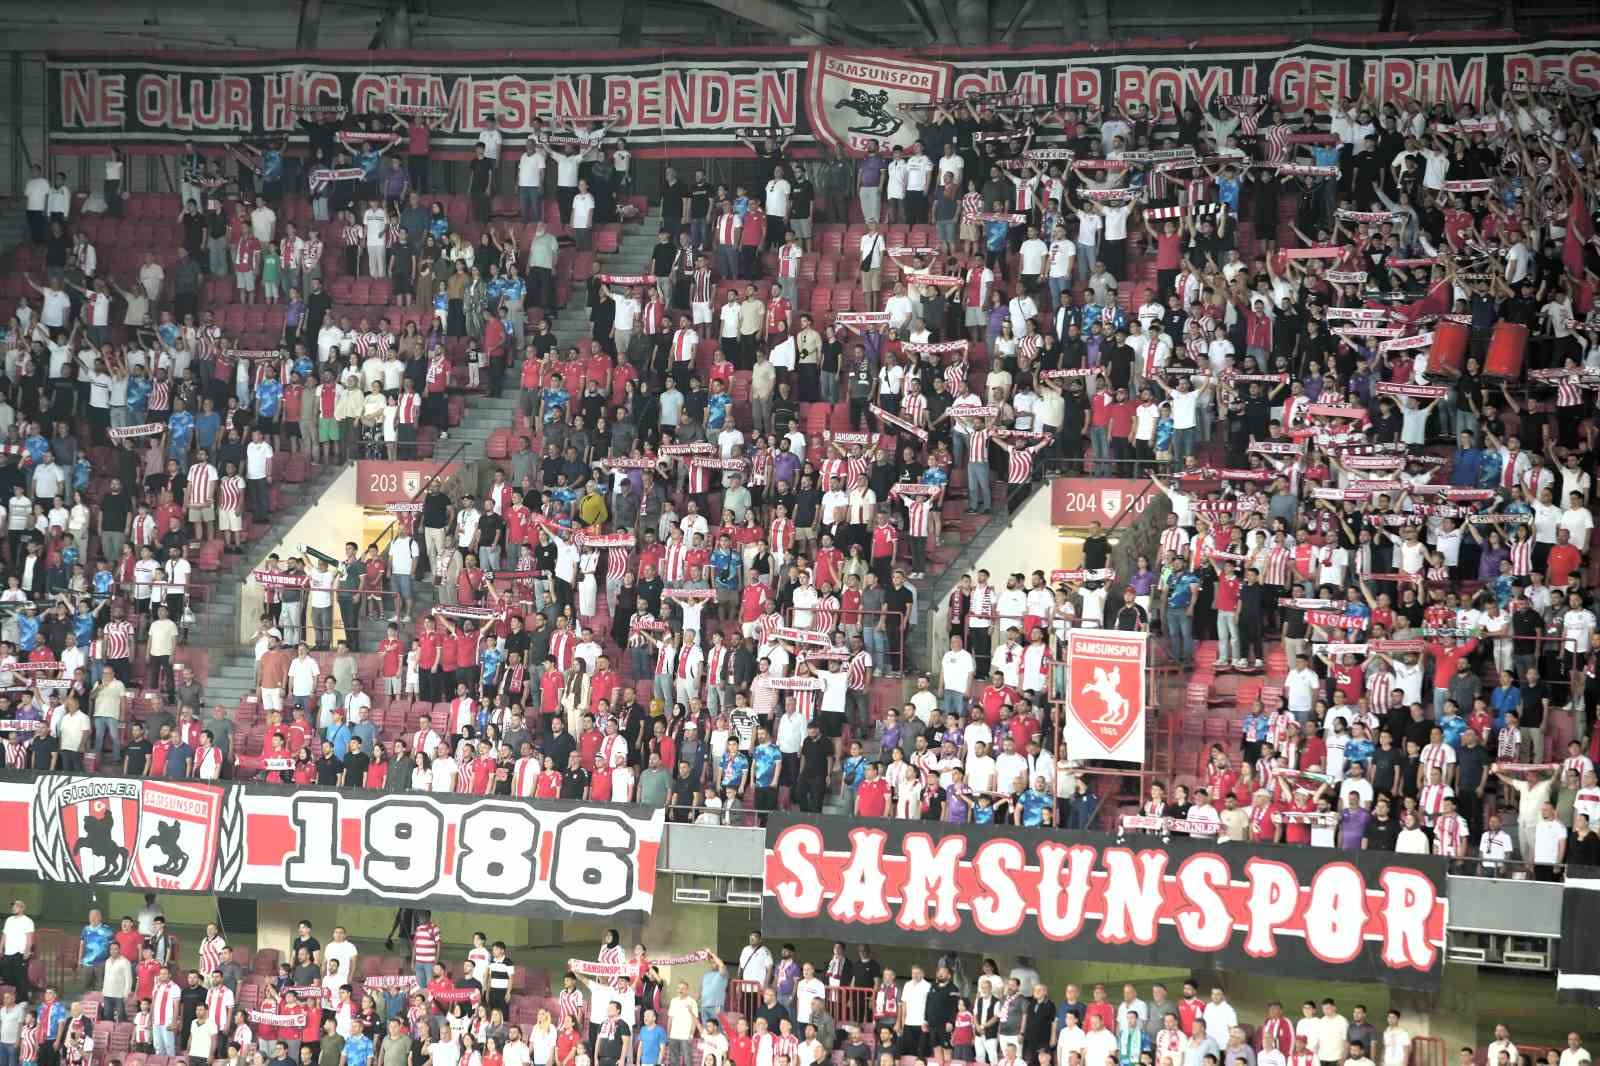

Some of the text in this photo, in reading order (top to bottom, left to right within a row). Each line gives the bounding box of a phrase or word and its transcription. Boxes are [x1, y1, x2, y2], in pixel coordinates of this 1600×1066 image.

[827, 60, 930, 88] SAMSUNSPOR
[61, 68, 127, 129] NE
[136, 73, 252, 132] OLUR
[602, 67, 799, 134] BENDEN
[851, 136, 892, 152] 195
[370, 474, 398, 492] 203
[1066, 492, 1097, 512] 204
[1075, 641, 1139, 656] SAMSUNSPOR
[62, 783, 137, 805] ŞİRİNLER
[144, 791, 208, 817] SAMSUNSPOR
[284, 795, 636, 910] 1986
[772, 823, 1438, 972] SAMSUNSPOR
